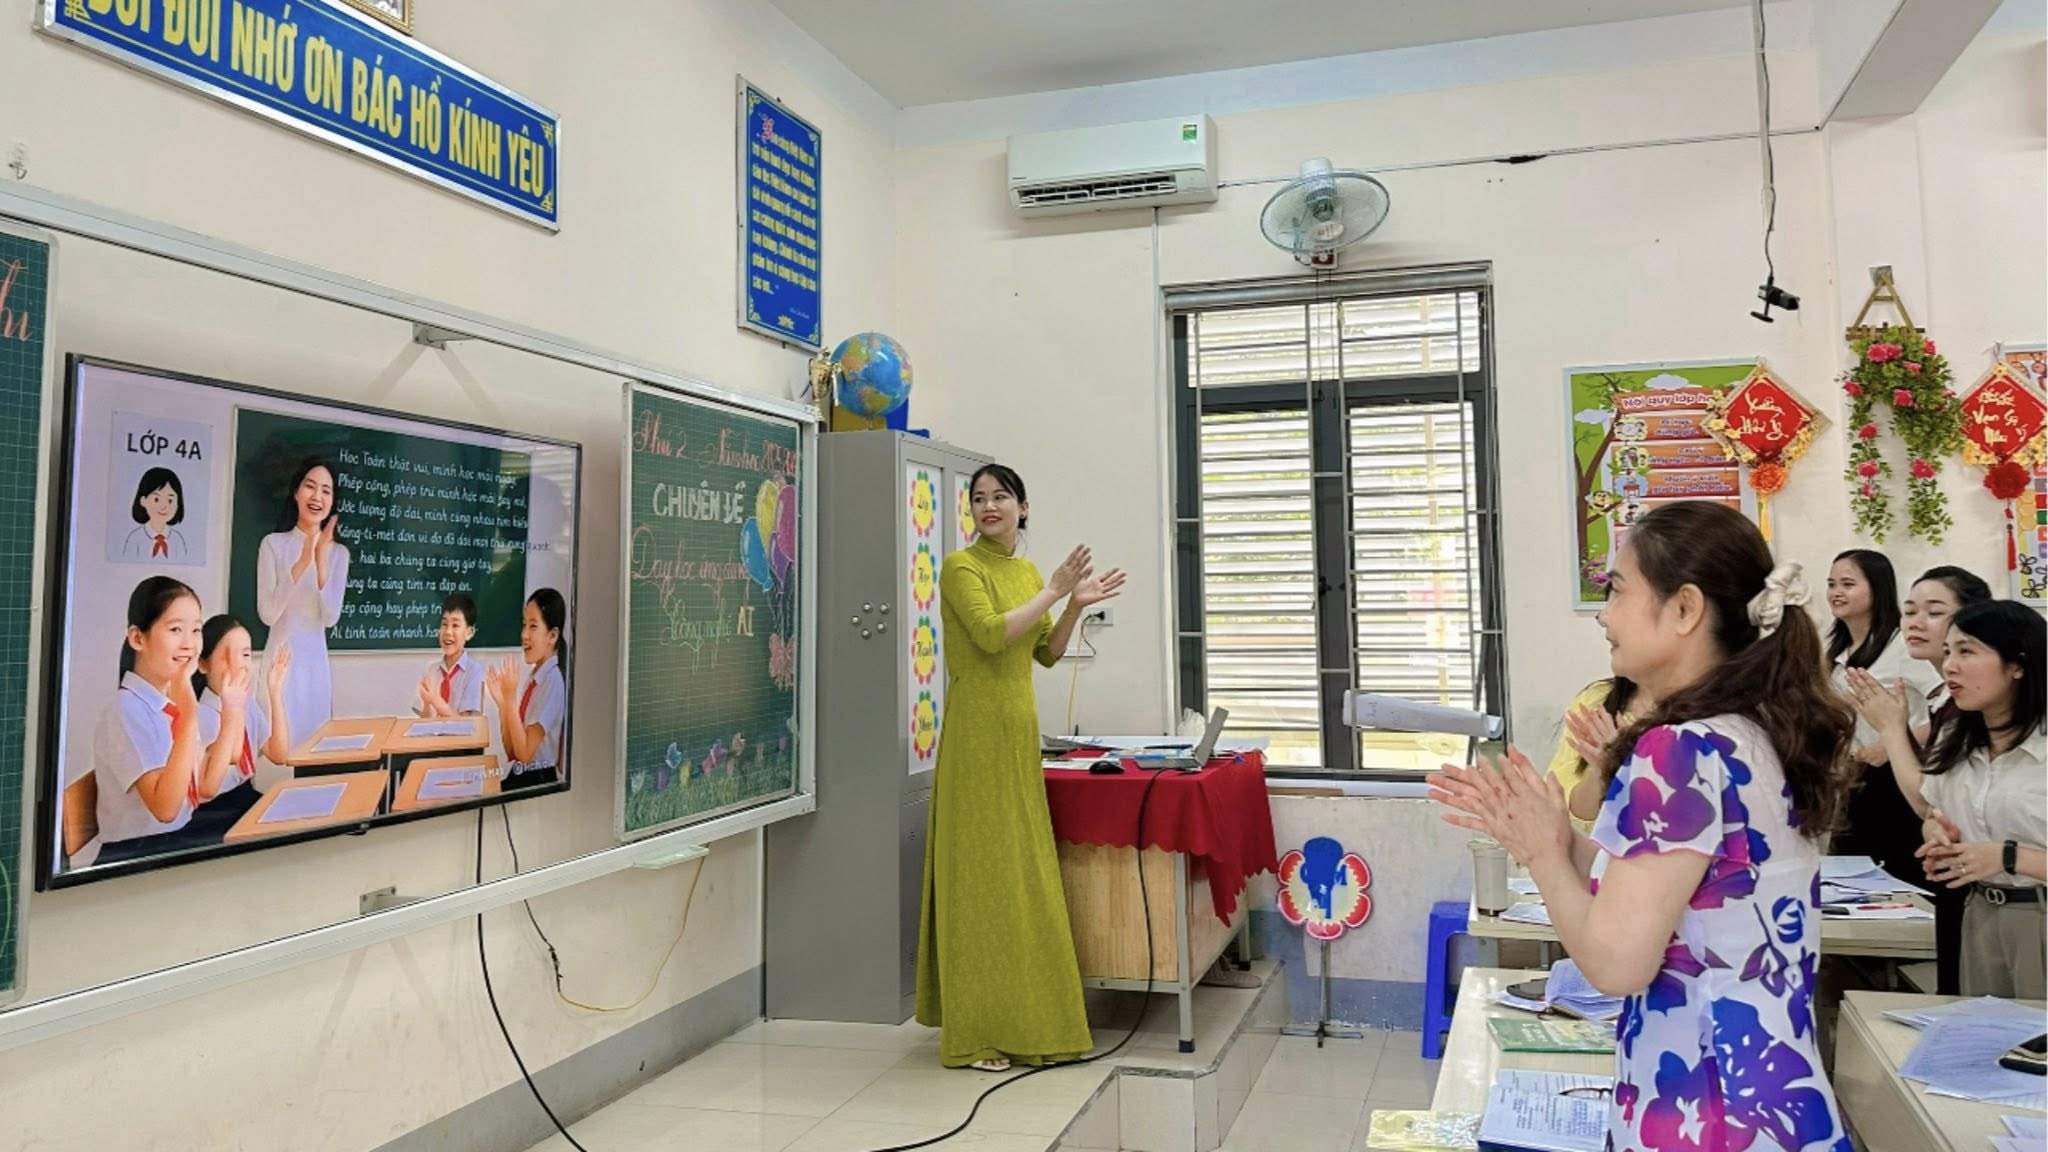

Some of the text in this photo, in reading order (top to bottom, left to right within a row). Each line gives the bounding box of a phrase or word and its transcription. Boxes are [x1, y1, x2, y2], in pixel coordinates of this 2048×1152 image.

[231, 1, 299, 93] NHỚ
[304, 35, 343, 114] ƠN
[351, 54, 403, 138] BÁC
[410, 75, 442, 154] HỒ
[449, 97, 501, 180] KÍNH
[507, 124, 544, 197] YÊU
[127, 429, 202, 460] LỚP 4A
[653, 479, 720, 521] CHUYÊN
[737, 605, 755, 637] AI
